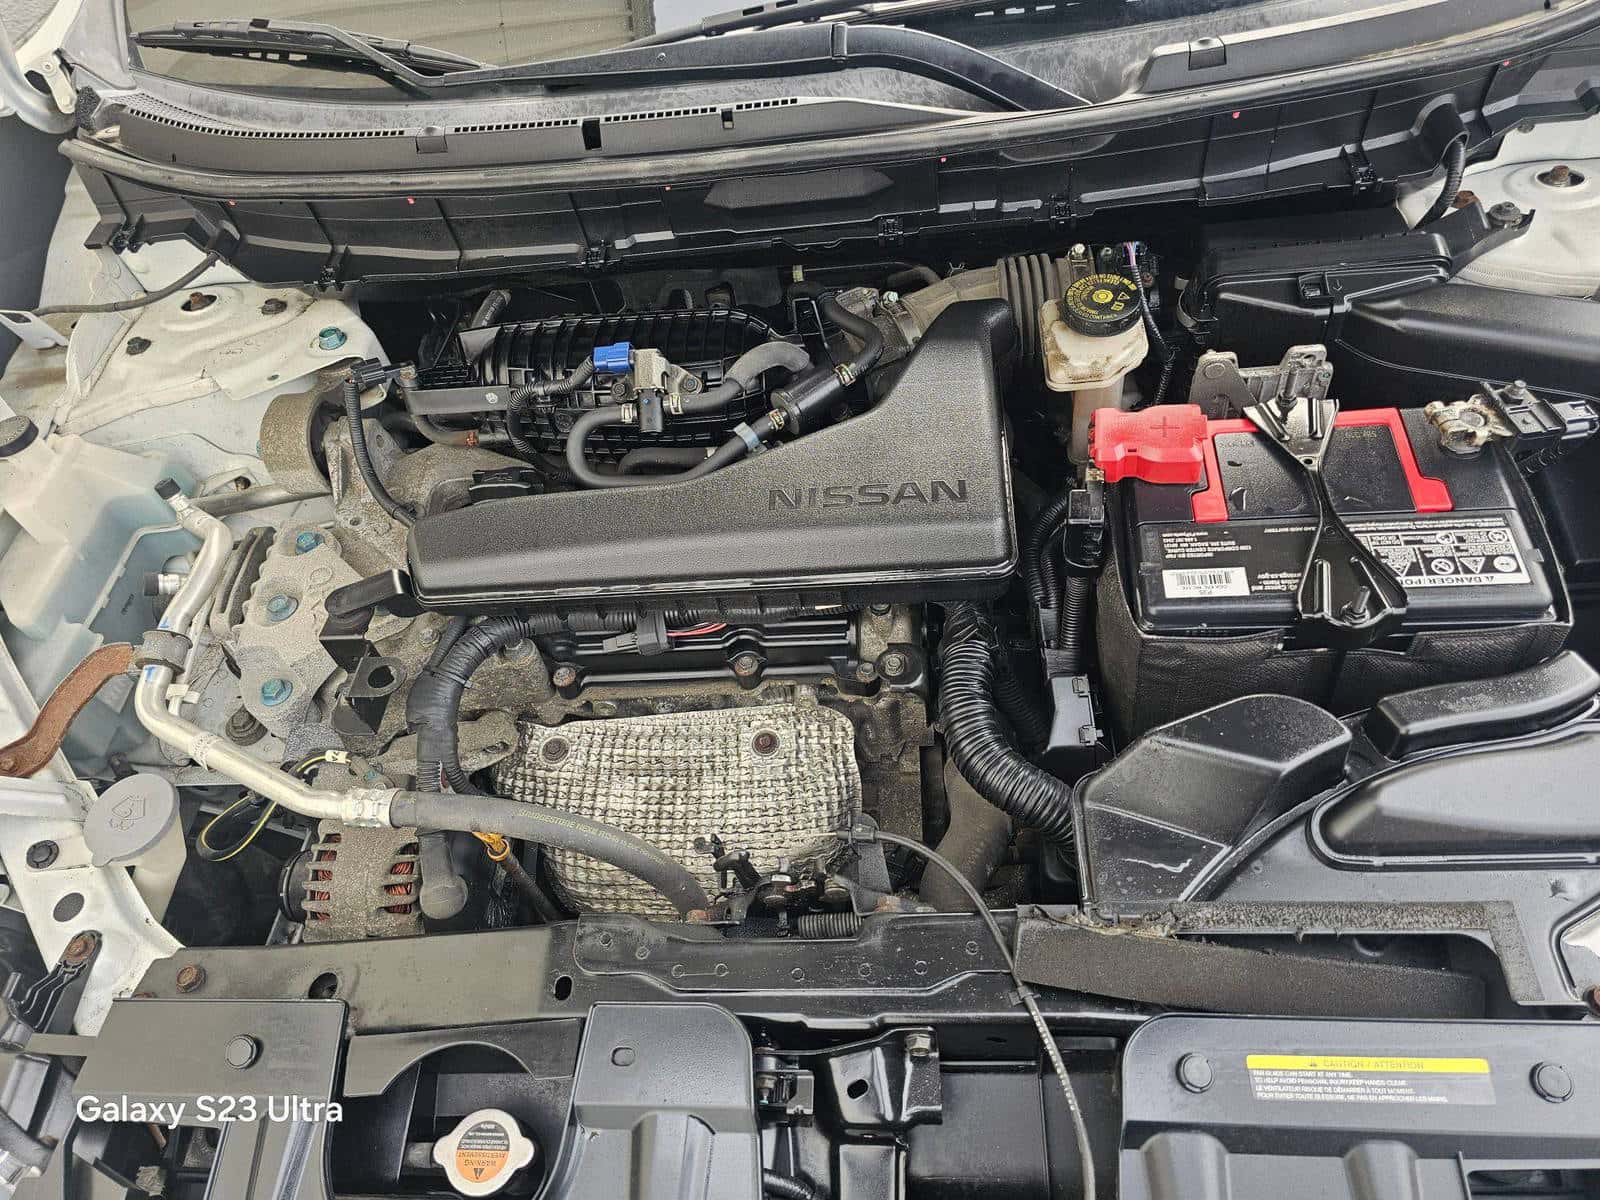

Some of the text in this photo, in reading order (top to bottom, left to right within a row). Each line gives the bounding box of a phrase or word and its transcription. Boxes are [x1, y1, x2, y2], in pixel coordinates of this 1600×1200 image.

[768, 479, 968, 510] NISSAN
[1323, 1059, 1363, 1069] CAUTION
[1373, 1060, 1425, 1070] ATTENTION
[1298, 1070, 1316, 1078] START
[463, 1159, 497, 1167] WARNING
